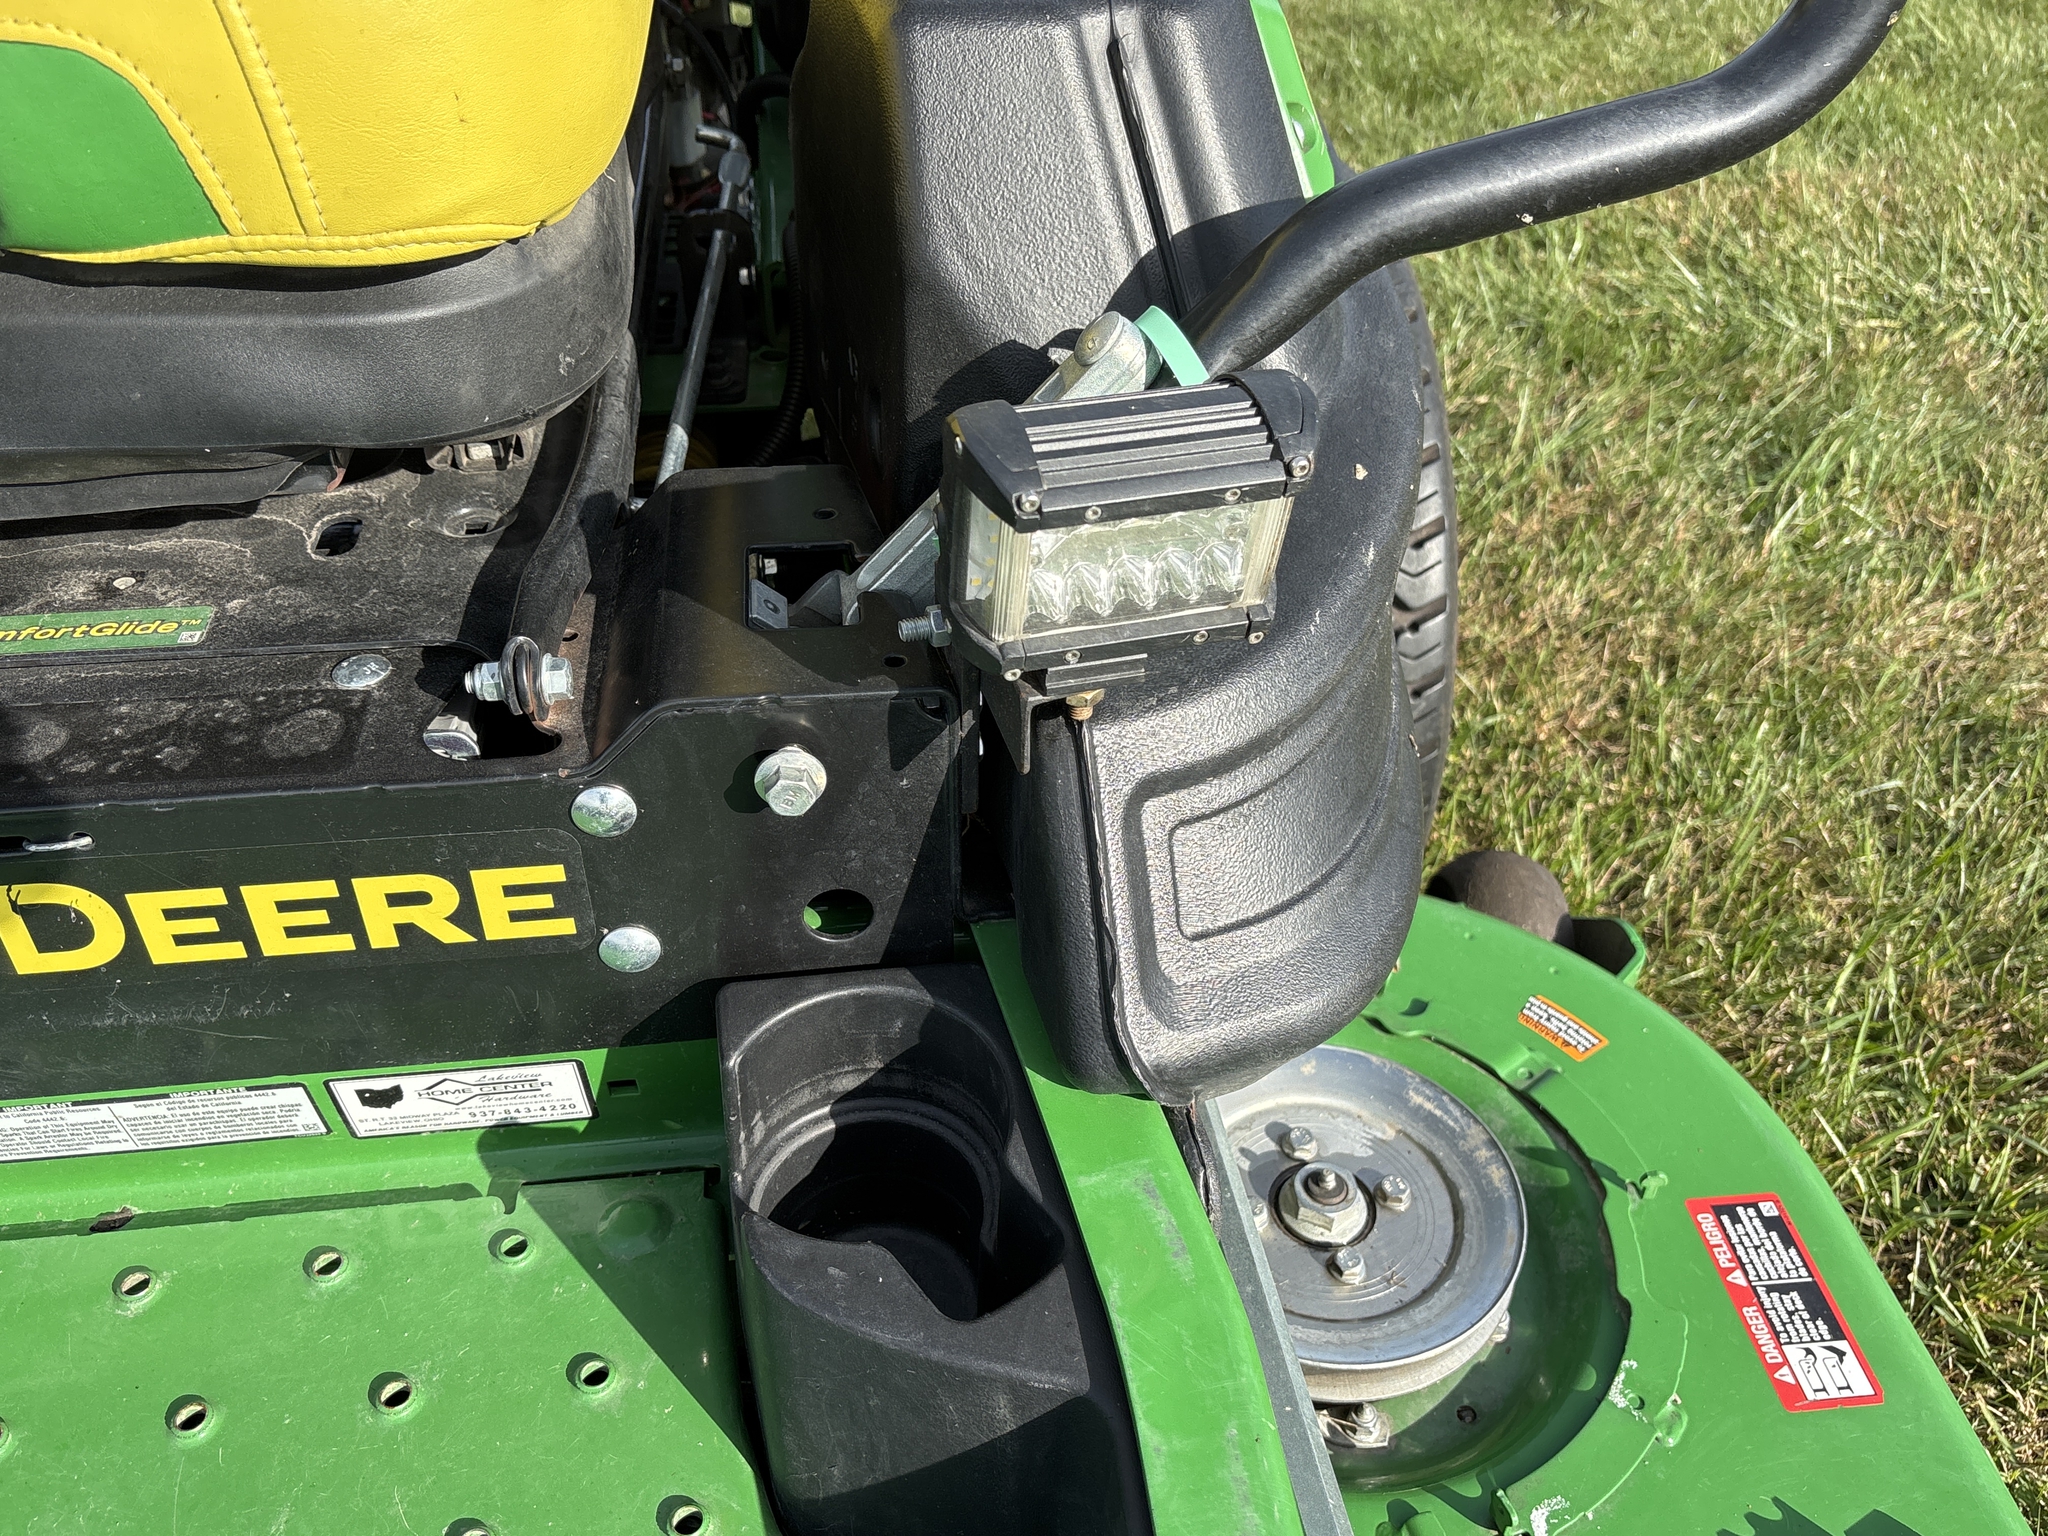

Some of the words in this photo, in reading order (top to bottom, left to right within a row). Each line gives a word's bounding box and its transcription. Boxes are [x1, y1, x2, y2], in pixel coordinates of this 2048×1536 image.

[0, 864, 577, 975] DEERE
[474, 1070, 542, 1082] Lakeview
[169, 1087, 247, 1098] IMPORTANTE
[418, 1087, 473, 1097] HOME
[479, 1080, 552, 1092] CENTER
[479, 1090, 552, 1102] Hardware
[2, 1102, 72, 1112] IMPORTANT
[469, 1101, 576, 1118] 937-843-4220
[1697, 1212, 1736, 1268] PELIGRO
[1755, 1285, 1774, 1308] injury
[1781, 1294, 1797, 1311] stay
[1789, 1290, 1805, 1310] deck
[1769, 1291, 1792, 1322] rotating
[1767, 1309, 1784, 1331] avoid
[1804, 1319, 1821, 1340] clear
[1814, 1316, 1833, 1339] edge.
[1741, 1305, 1783, 1363] DANGER
[1778, 1332, 1790, 1343] To
[1785, 1323, 1800, 1342] from
